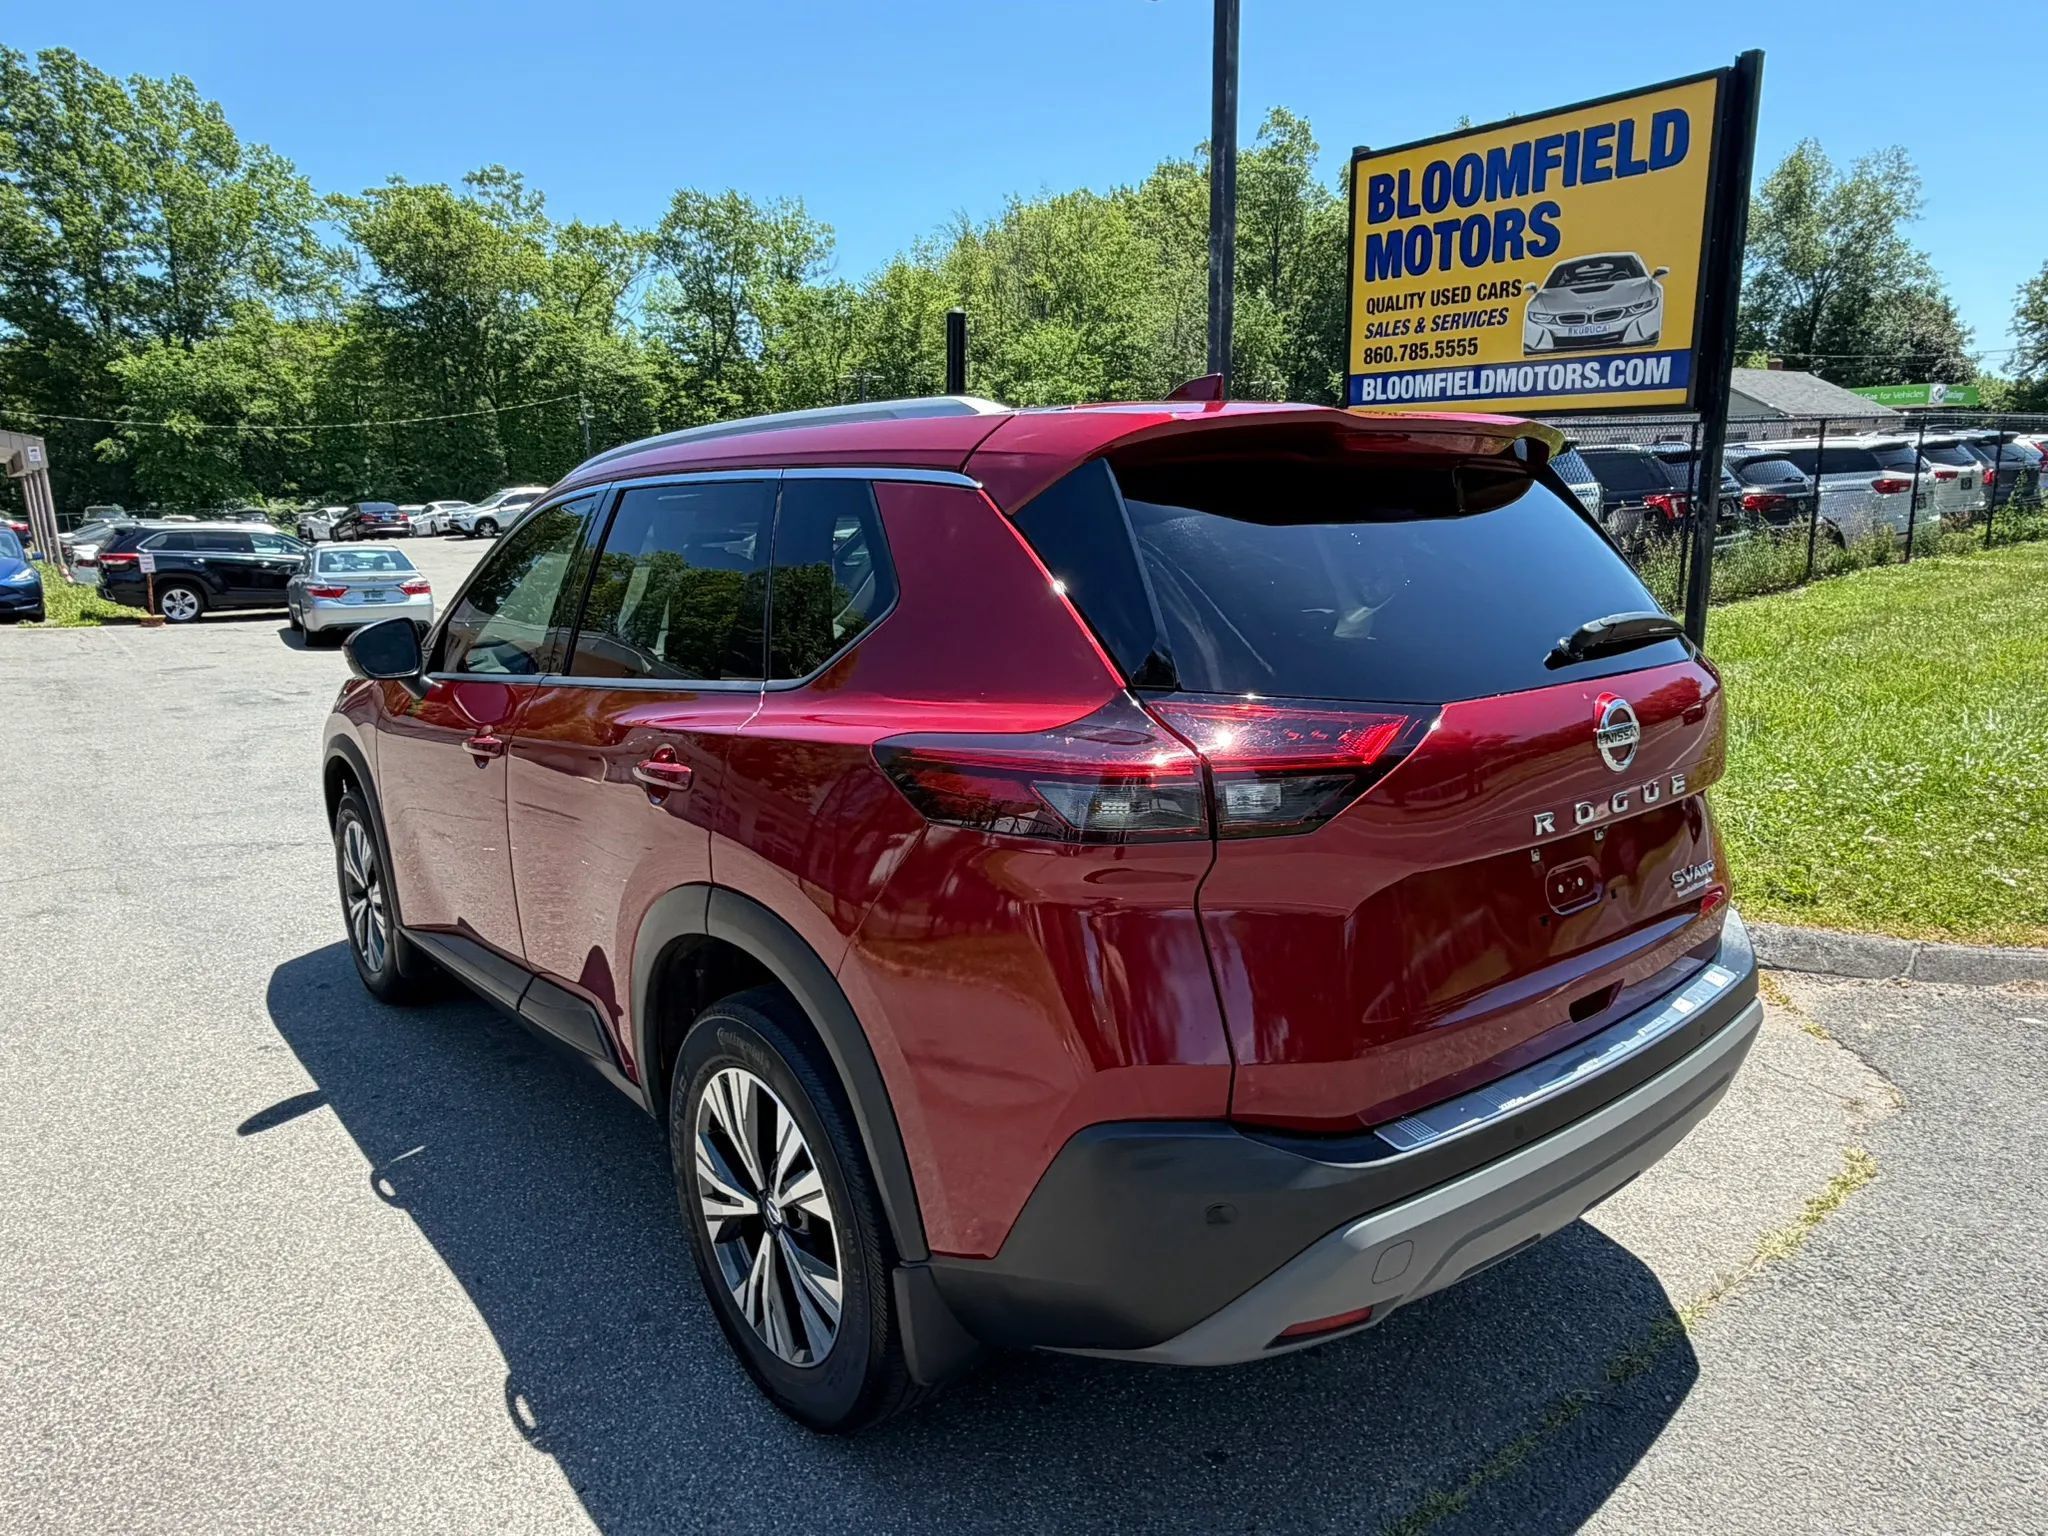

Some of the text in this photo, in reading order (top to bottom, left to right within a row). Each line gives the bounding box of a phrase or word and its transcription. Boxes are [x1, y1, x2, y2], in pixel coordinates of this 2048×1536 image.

[1367, 107, 1690, 225] BLOOMFIELD
[1365, 201, 1561, 283] MOTORS
[1366, 278, 1522, 315] QUALITY USED CARS
[1365, 307, 1509, 340] SALES & SERVICES
[1363, 337, 1479, 366] 860.785.5555
[1361, 355, 1672, 402] BLOOMFIELDMOTORS.COM
[1880, 391, 1892, 399] for
[1893, 390, 1925, 399] Vehicles
[1533, 773, 1686, 836] ROGUE
[1671, 864, 1694, 888] SV
